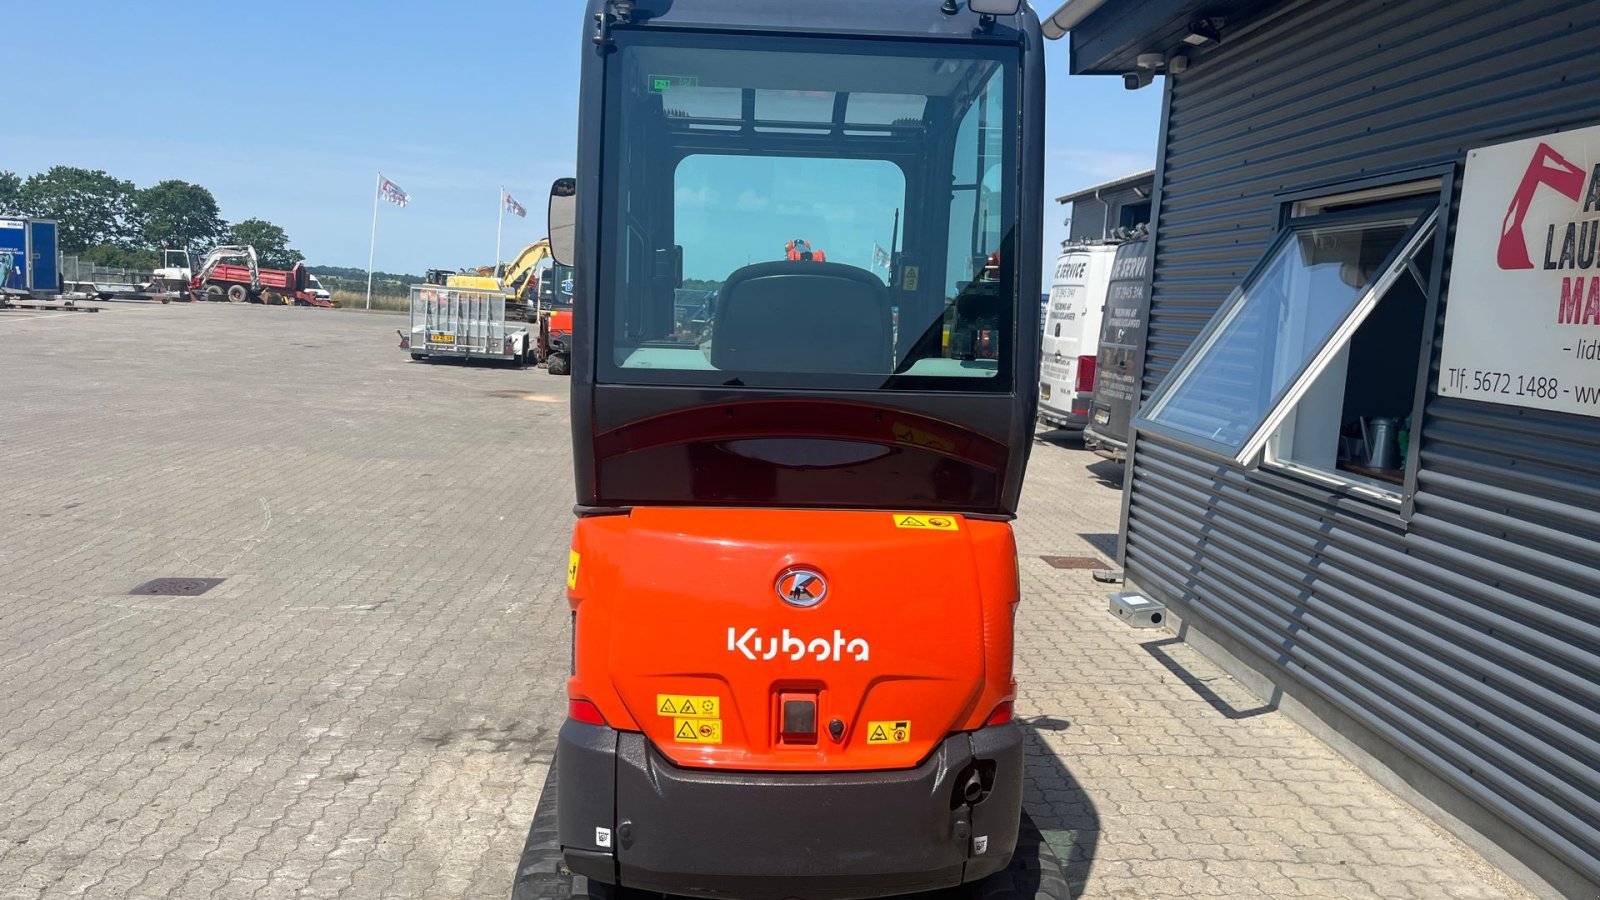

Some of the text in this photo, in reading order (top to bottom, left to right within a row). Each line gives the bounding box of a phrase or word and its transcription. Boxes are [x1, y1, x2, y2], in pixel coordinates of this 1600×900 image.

[1543, 220, 1600, 270] LAU
[1059, 262, 1087, 279] SERVICE
[1120, 256, 1147, 278] SERVI
[1449, 368, 1468, 394] Tlf.
[1473, 370, 1511, 394] 5672
[1516, 375, 1558, 400] 1488
[727, 627, 870, 662] Kubota
